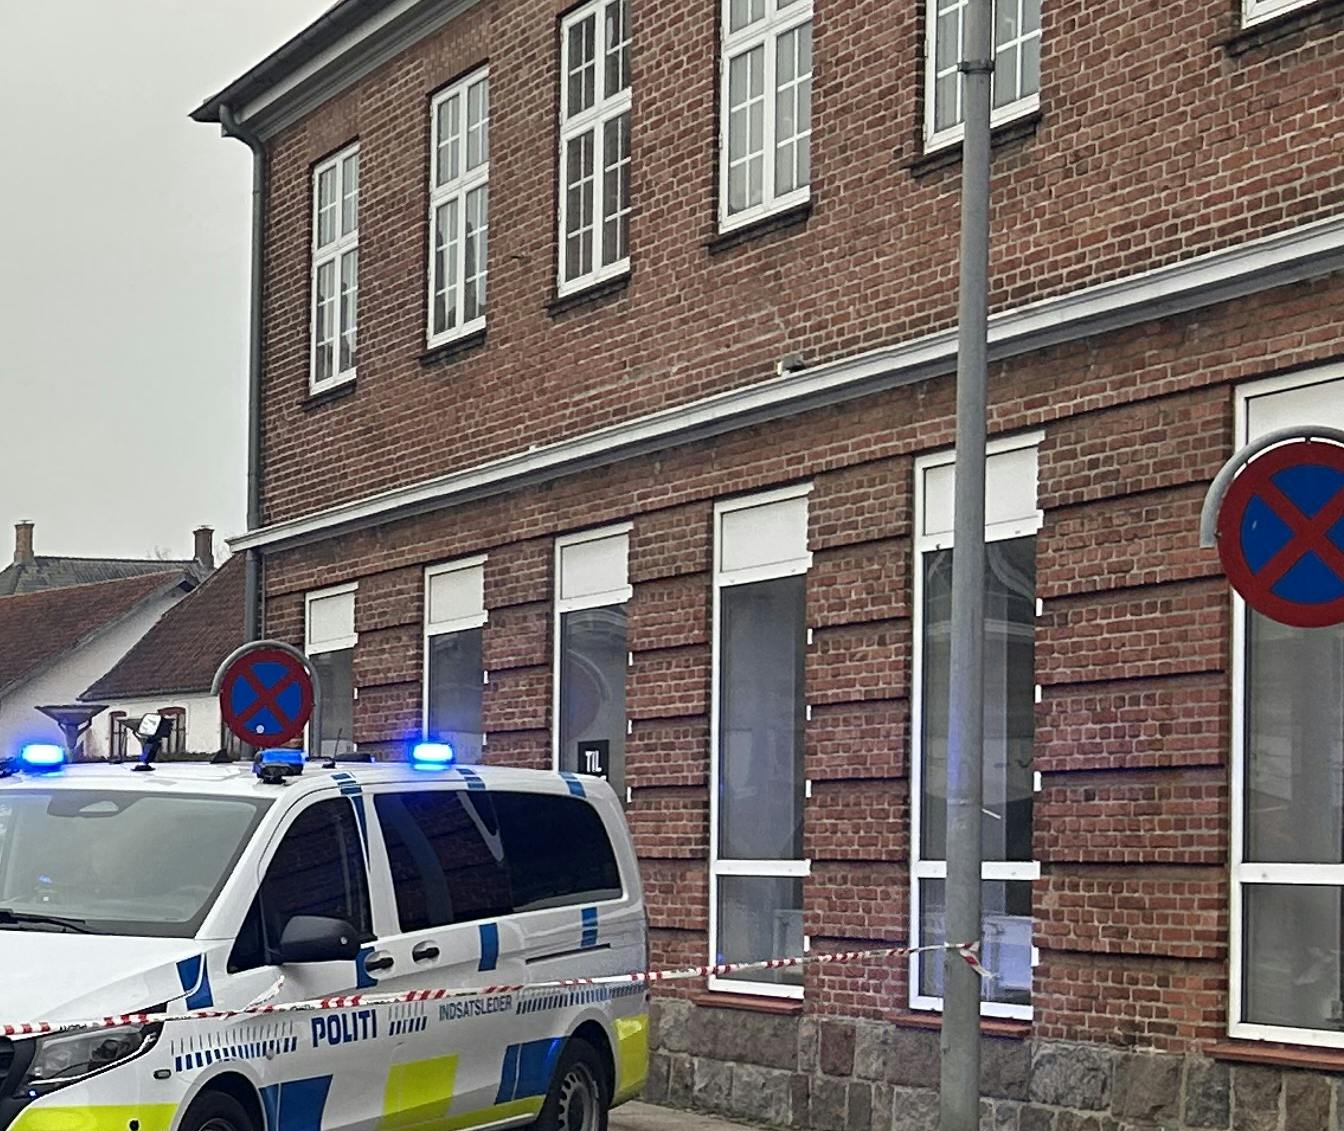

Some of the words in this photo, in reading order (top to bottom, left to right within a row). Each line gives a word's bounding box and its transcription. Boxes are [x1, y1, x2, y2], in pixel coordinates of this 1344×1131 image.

[585, 750, 602, 773] TIL
[439, 994, 512, 1021] INDSATSLEDER
[311, 1009, 378, 1048] POLITI
